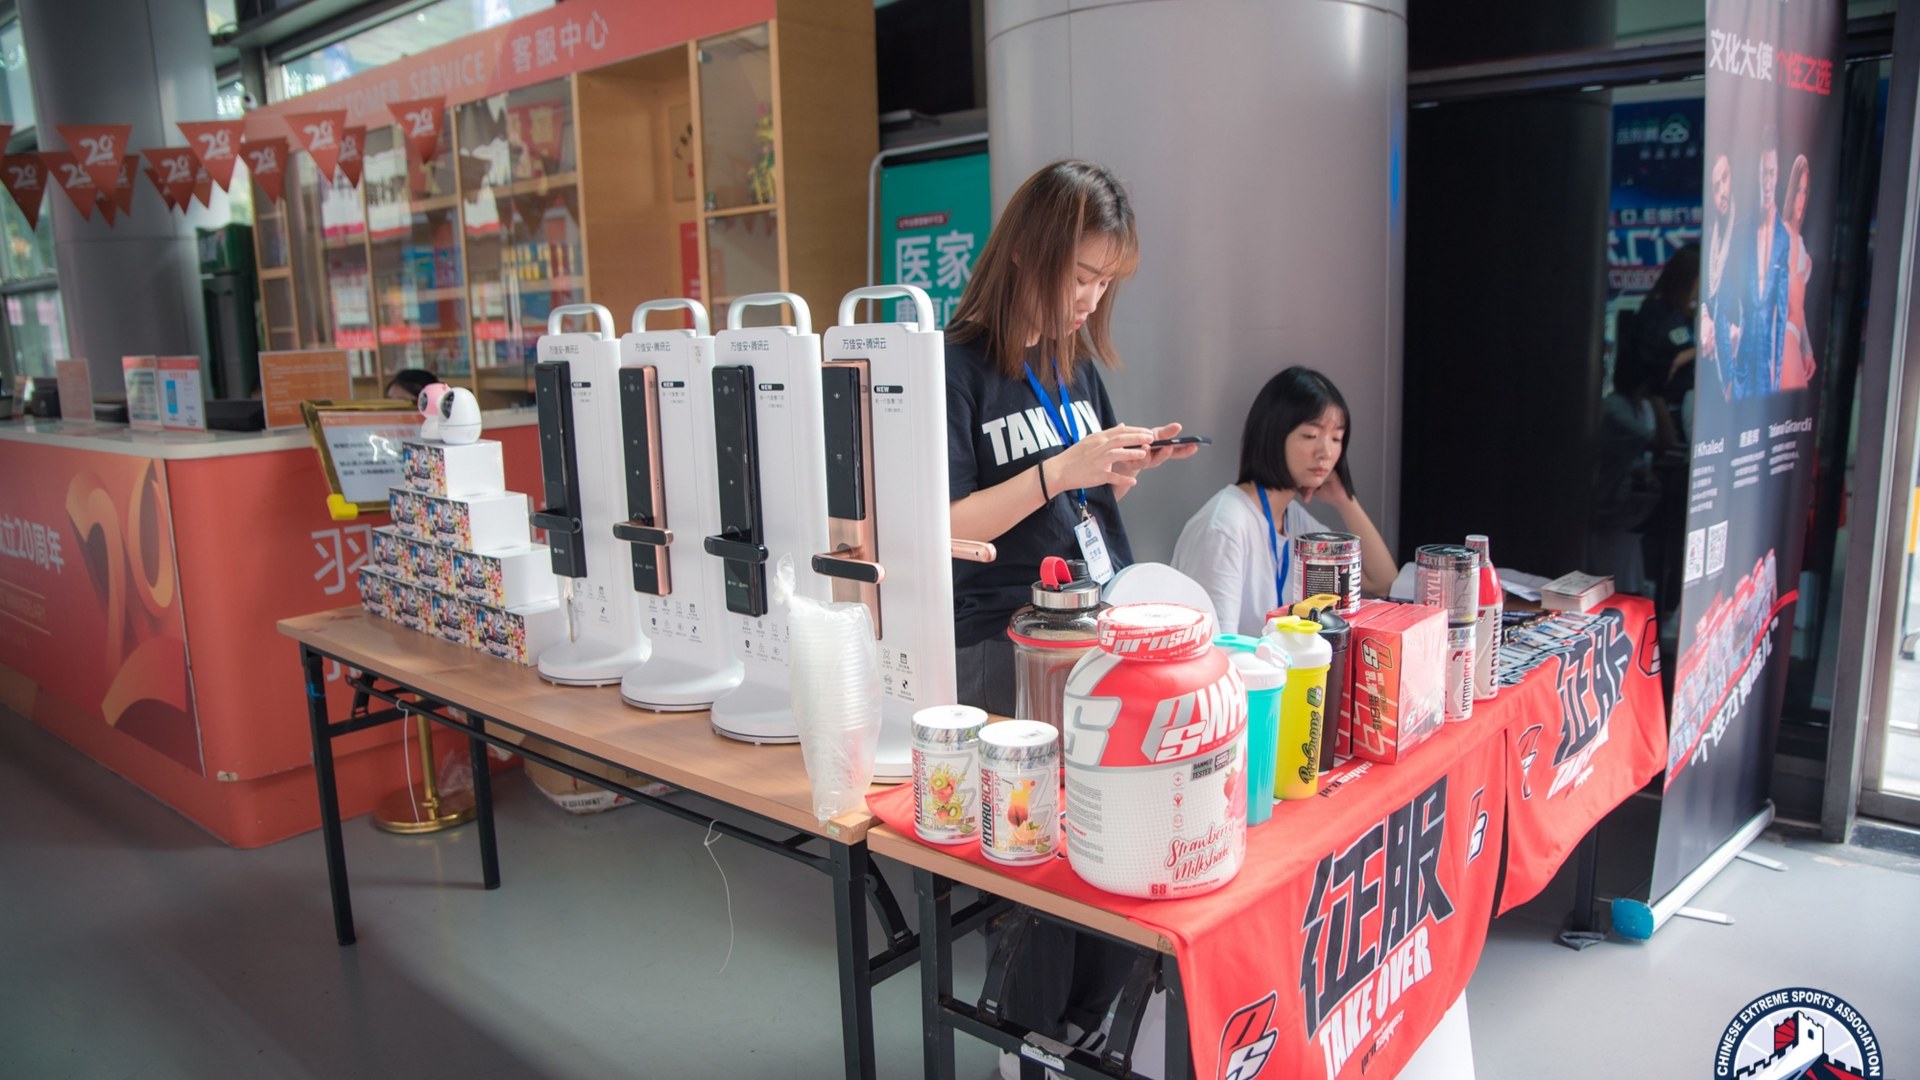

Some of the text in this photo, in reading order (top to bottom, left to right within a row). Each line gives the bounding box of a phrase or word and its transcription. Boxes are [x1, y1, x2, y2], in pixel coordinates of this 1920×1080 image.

[511, 11, 608, 74] 客服中心
[1709, 29, 1833, 95] 文化大使 个性之选
[409, 50, 486, 101] SERVICE
[896, 229, 975, 289] 医家
[981, 406, 1064, 466] TAK
[0, 513, 65, 576] 立20周年
[1426, 571, 1441, 606] EKYLL
[1192, 768, 1212, 780] TESTED
[1193, 758, 1213, 770] BANNED
[980, 767, 992, 848] HYDROBCAA
[1165, 820, 1236, 868] Strawberry
[1174, 844, 1230, 881] Milkshake
[1151, 883, 1167, 896] 68
[1299, 774, 1455, 1044] 征服
[1318, 925, 1433, 1080] TAKE OVER
